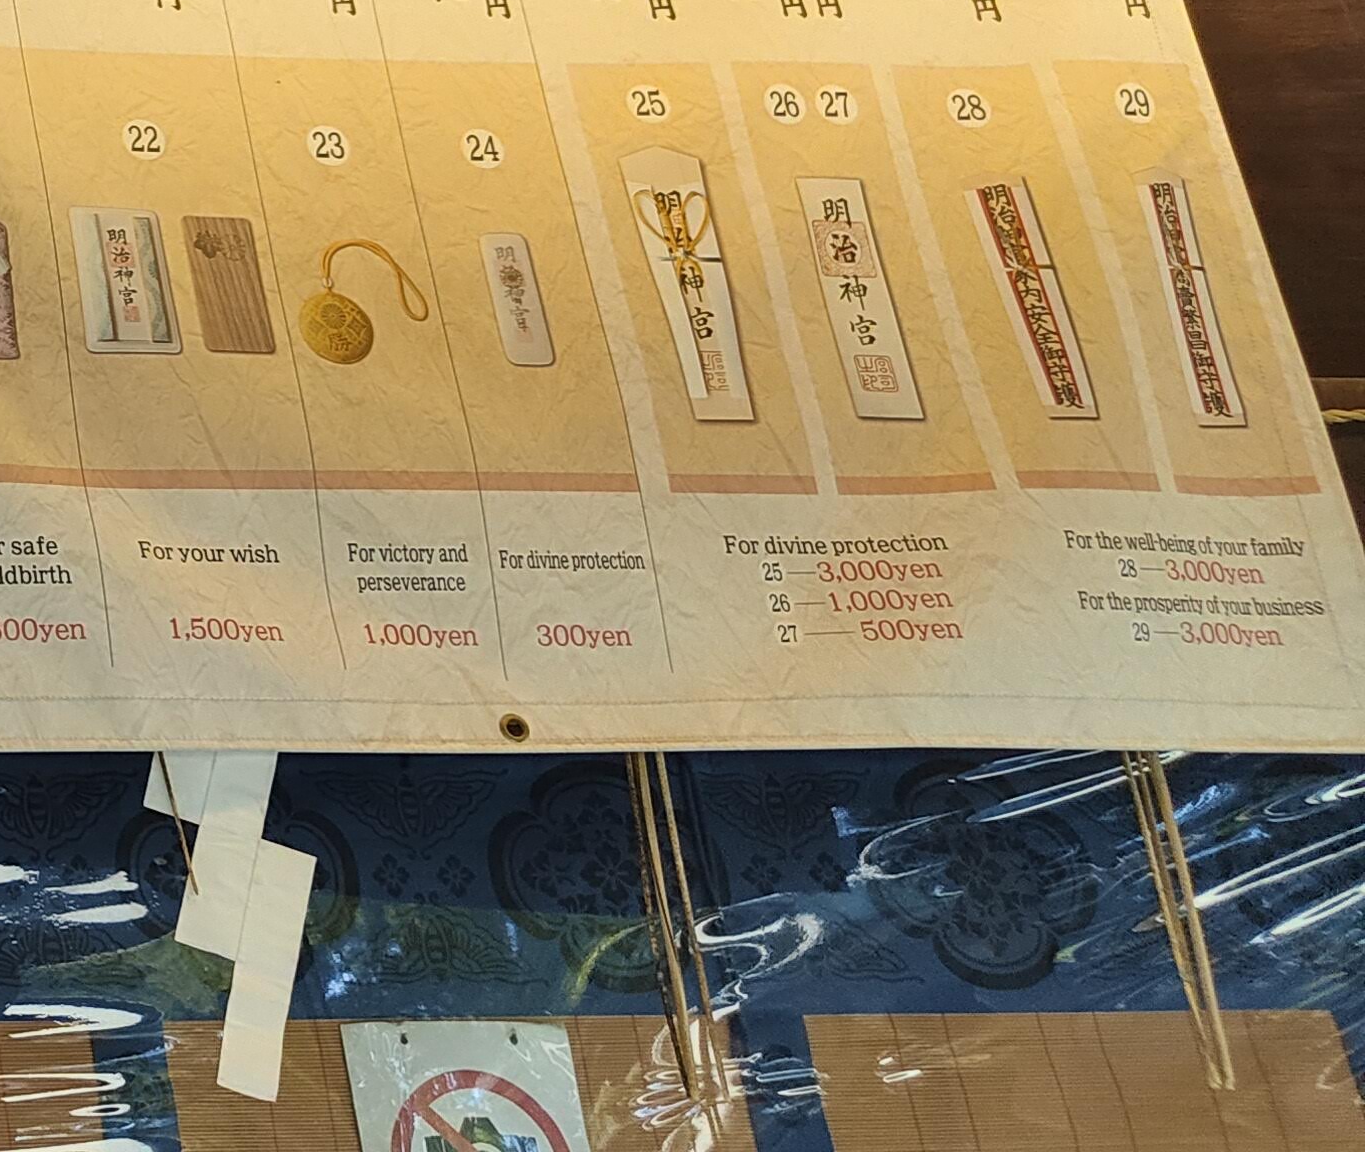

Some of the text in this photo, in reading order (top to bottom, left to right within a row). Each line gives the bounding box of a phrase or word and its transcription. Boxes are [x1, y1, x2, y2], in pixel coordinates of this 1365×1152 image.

[631, 89, 666, 117] 25
[769, 90, 800, 118] 26
[819, 90, 849, 118] 27
[951, 94, 987, 121] 28
[1119, 88, 1150, 117] 29
[128, 125, 161, 153] 22
[312, 131, 345, 160] 23
[466, 134, 500, 162] 24
[106, 228, 139, 307] 明治神宮
[820, 197, 878, 347] 明治神宮
[10, 535, 59, 556] safe
[137, 540, 281, 564] For your wish
[346, 542, 469, 565] For victory and
[722, 533, 949, 557] For divine protection
[1063, 529, 1305, 558] For the well-being of your family
[497, 549, 646, 573] For divine protection
[356, 576, 467, 594] perseverance
[169, 616, 285, 643] 1,500yen
[363, 623, 479, 649] 1,000yen
[536, 624, 633, 650] 300yen
